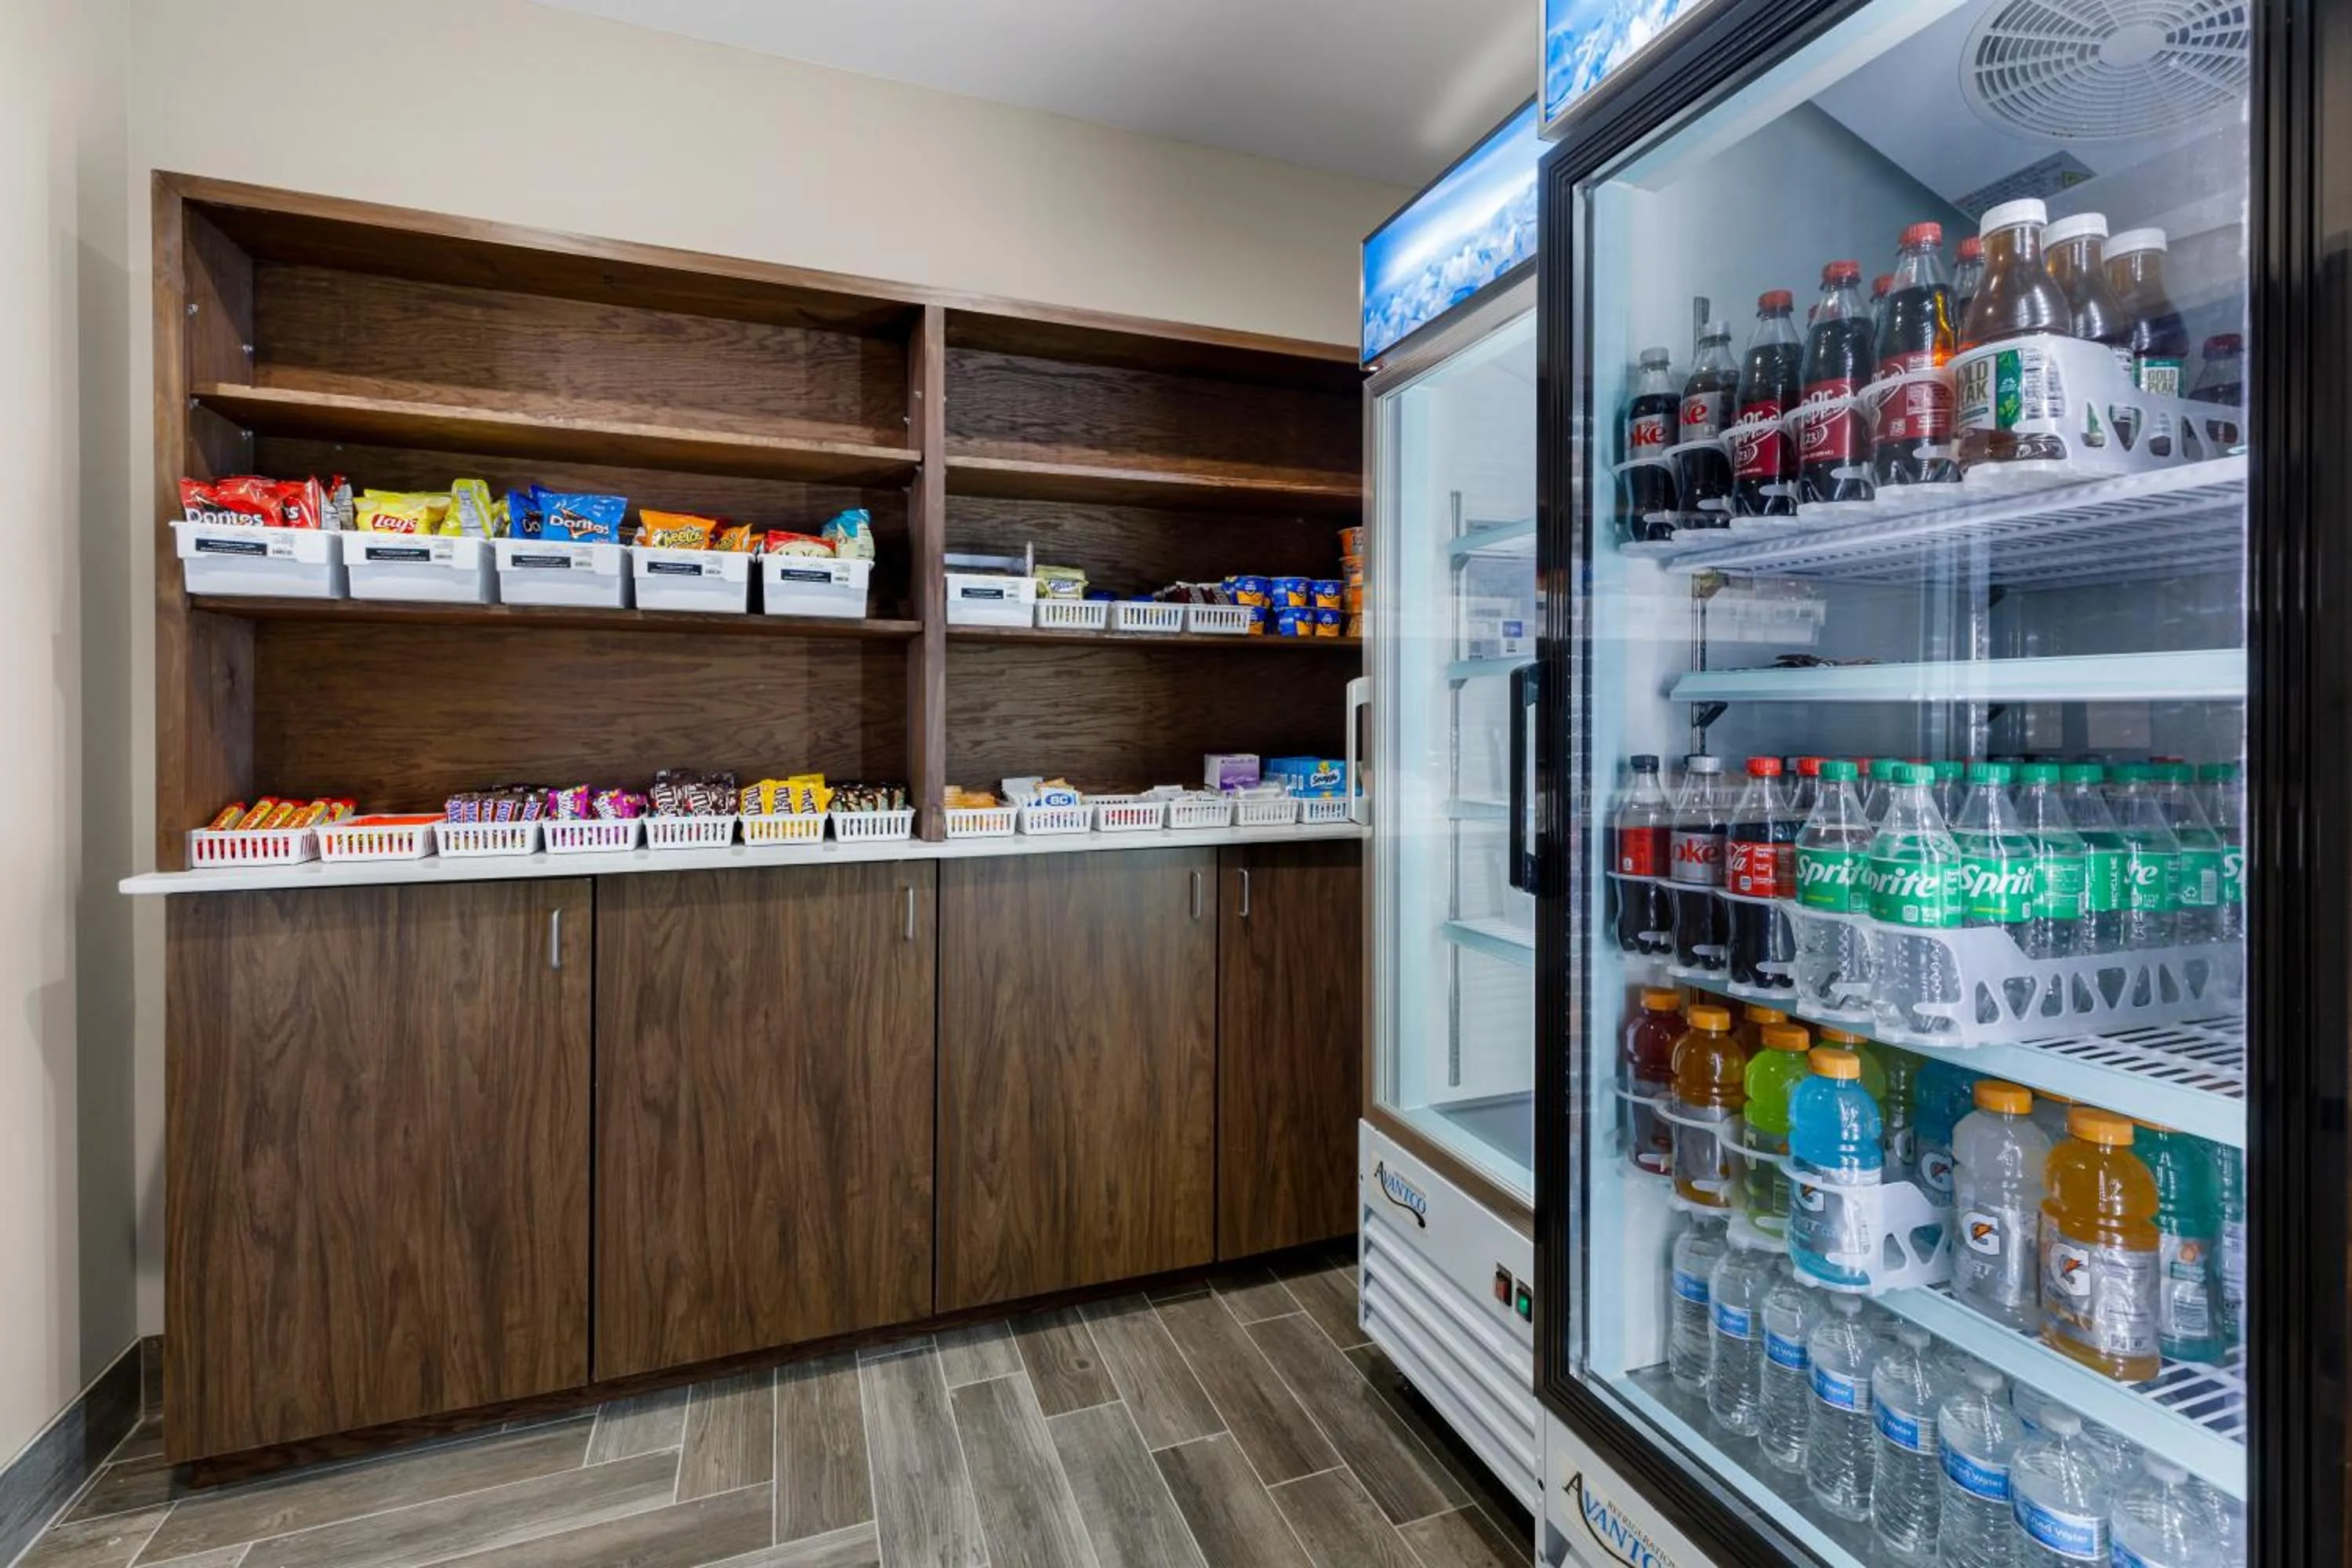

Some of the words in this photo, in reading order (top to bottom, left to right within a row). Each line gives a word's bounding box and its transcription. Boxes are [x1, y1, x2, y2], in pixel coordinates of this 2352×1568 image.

[550, 514, 609, 535] Doritos
[1051, 795, 1069, 806] BC
[1675, 837, 1719, 865] oke
[1961, 863, 2034, 898] Sprit
